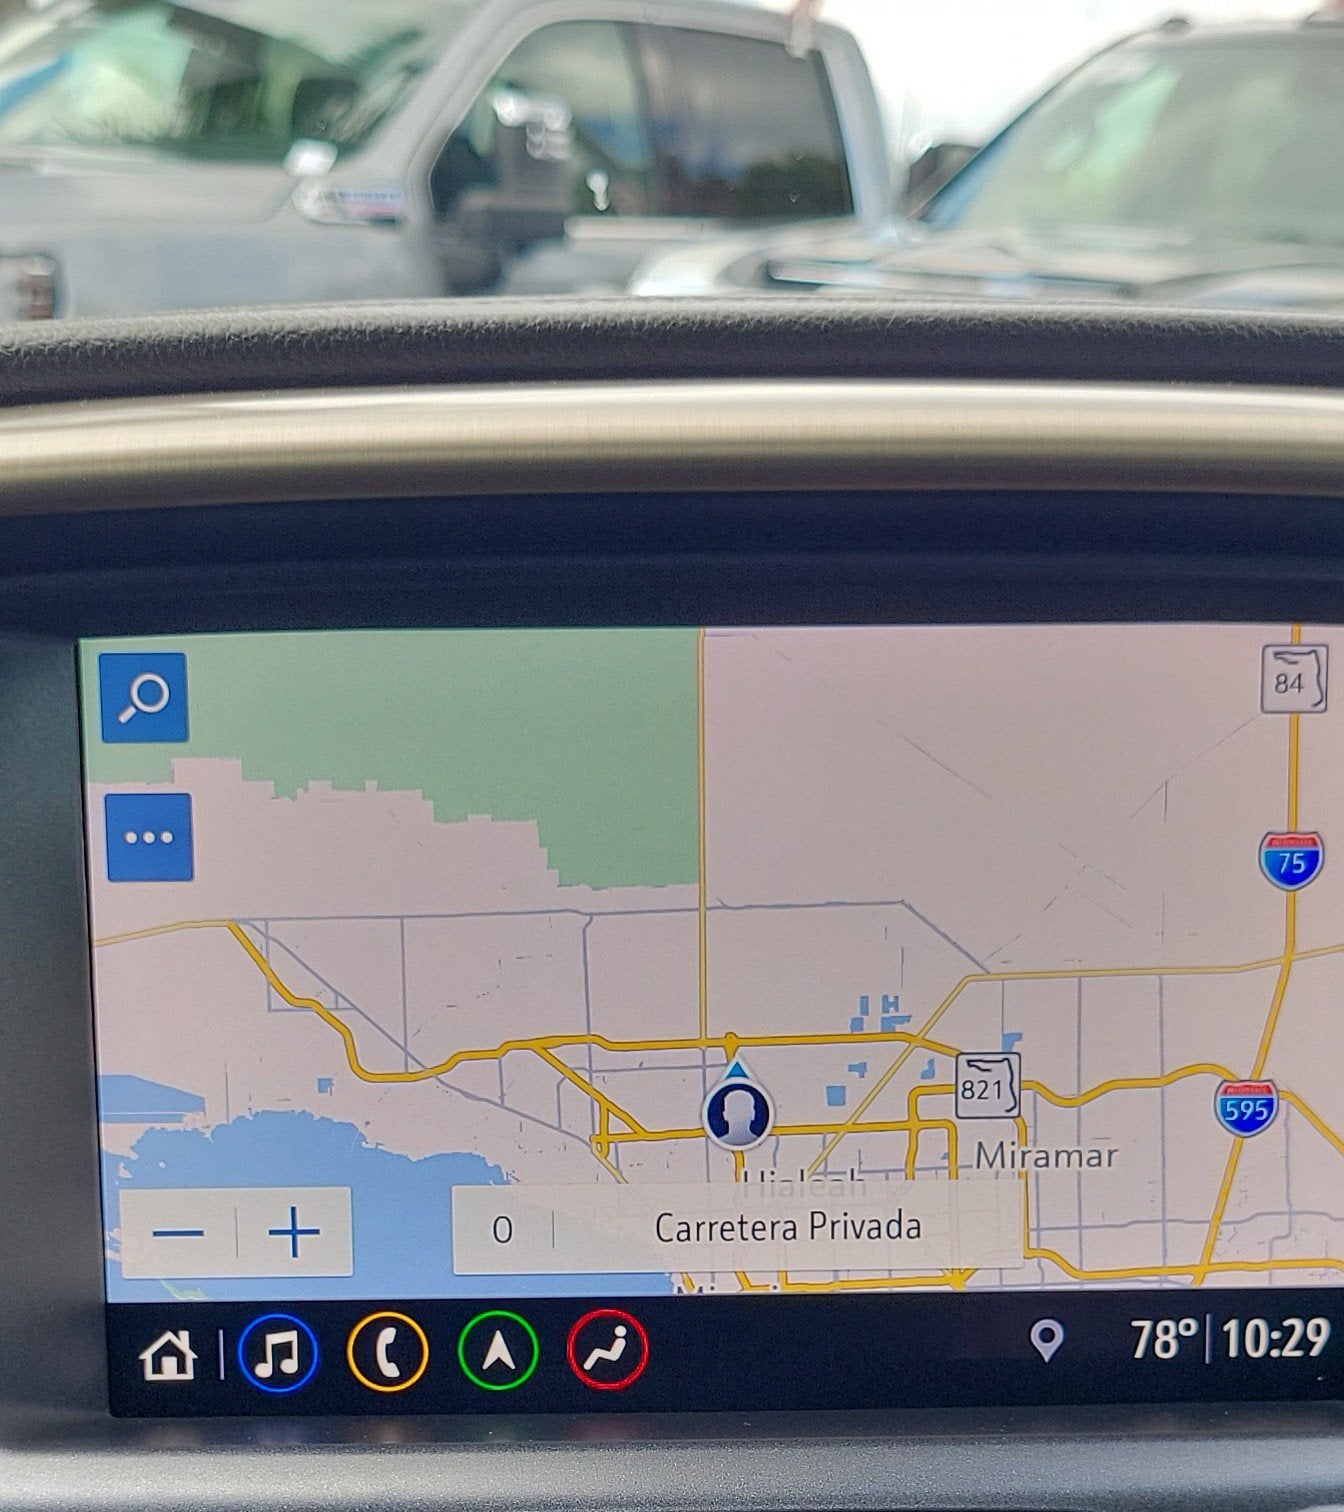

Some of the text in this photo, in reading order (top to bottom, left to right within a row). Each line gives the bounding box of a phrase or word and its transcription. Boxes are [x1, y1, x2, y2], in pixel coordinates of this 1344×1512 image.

[1275, 672, 1304, 694] 84
[1279, 852, 1306, 874] 75
[961, 1079, 1002, 1100] 821
[1224, 1100, 1268, 1121] 595
[976, 1140, 1119, 1169] Miramar
[656, 1208, 921, 1242] Carretera Privada
[1222, 1316, 1332, 1358] 10:29
